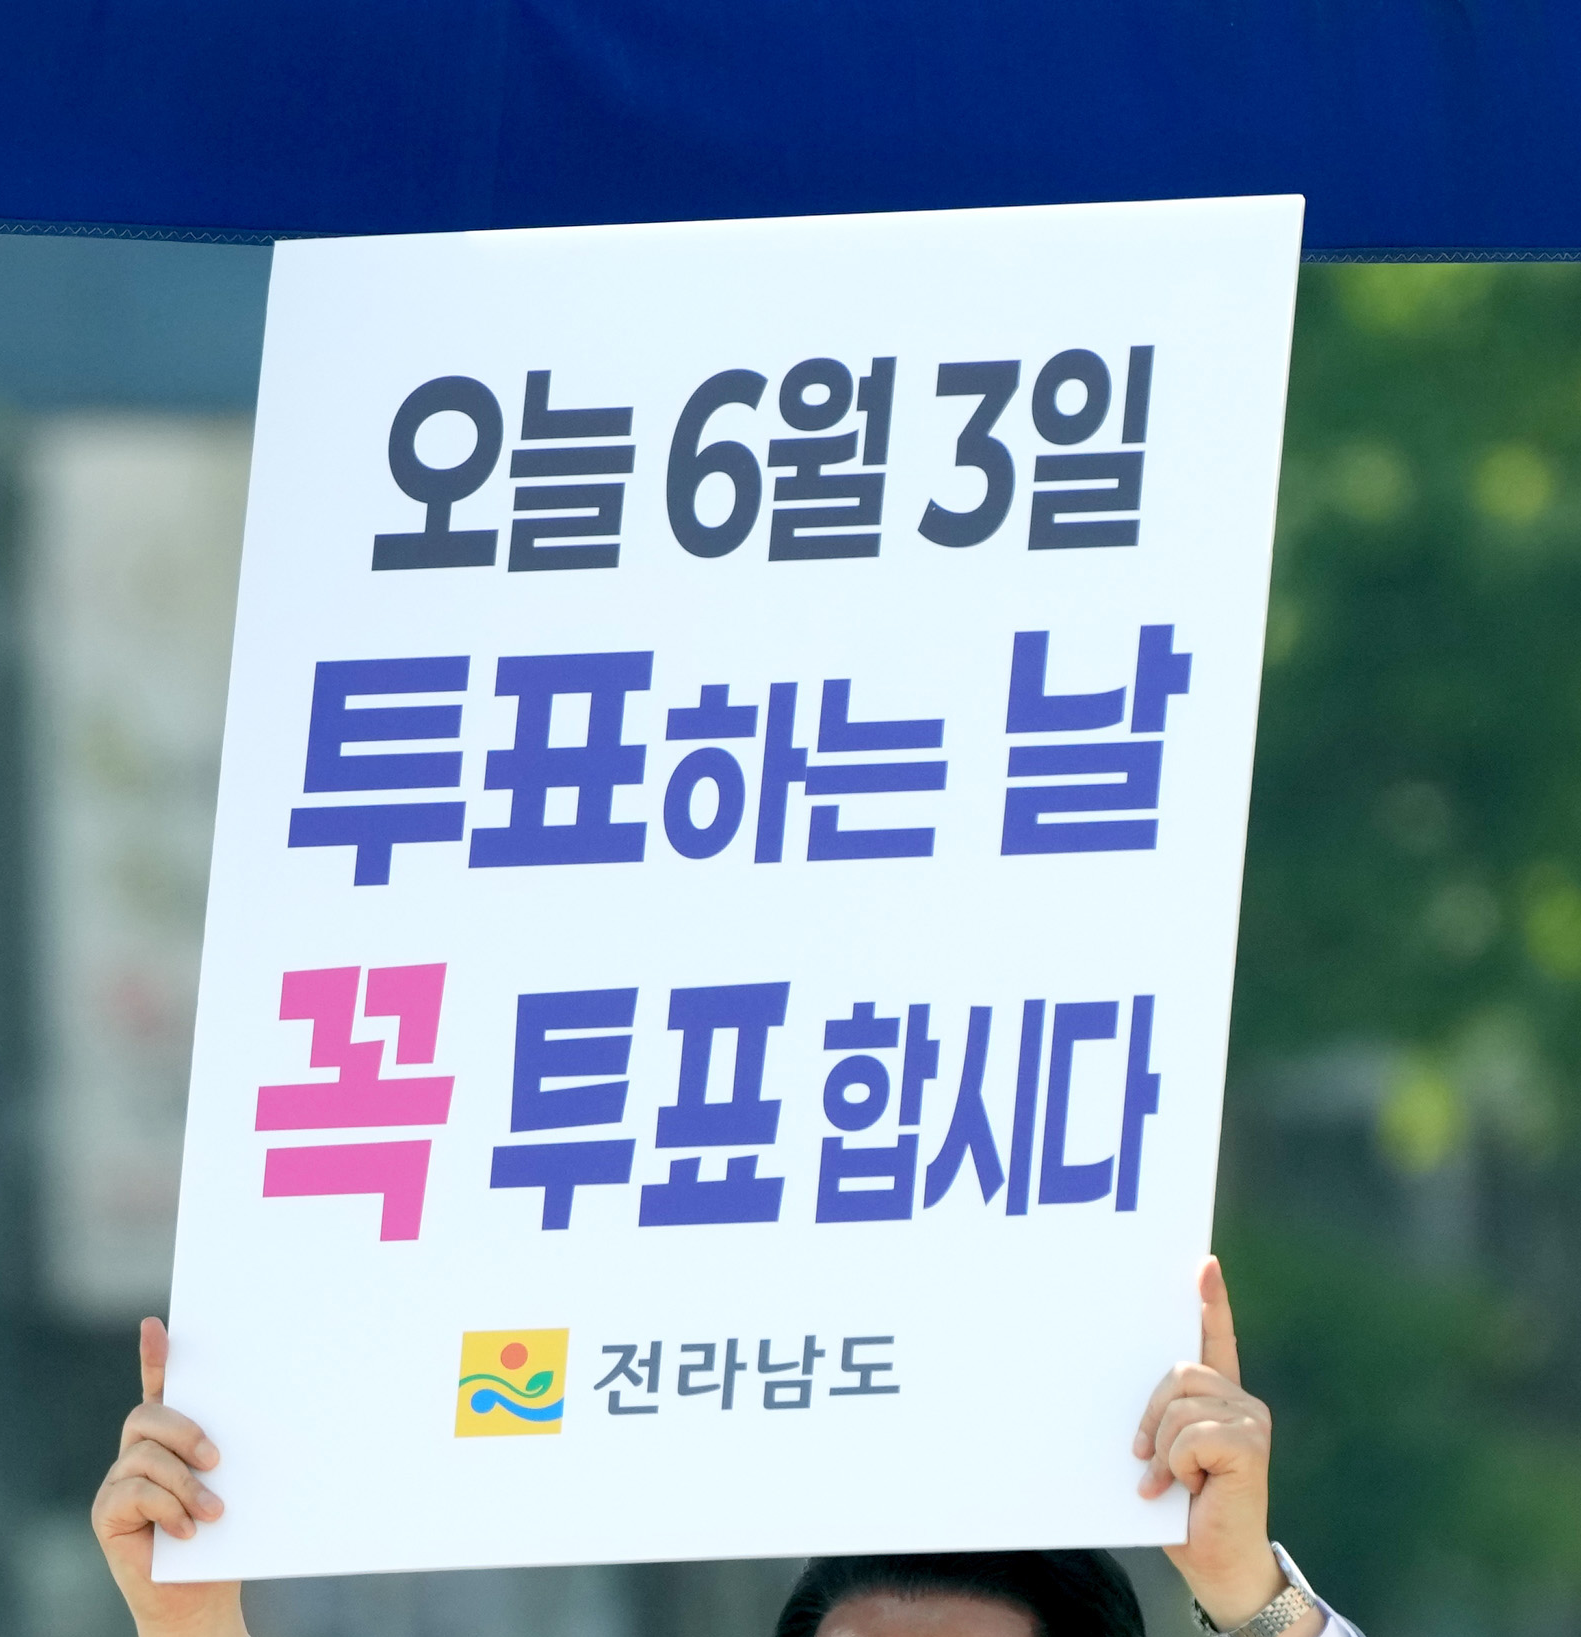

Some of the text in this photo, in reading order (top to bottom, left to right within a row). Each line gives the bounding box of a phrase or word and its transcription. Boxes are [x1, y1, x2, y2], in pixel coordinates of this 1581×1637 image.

[372, 345, 1155, 572] 오늘 6월 3일
[288, 624, 1192, 886] 투표하는 날
[255, 963, 455, 1241] 꼭
[593, 1335, 900, 1415] 전라남도
